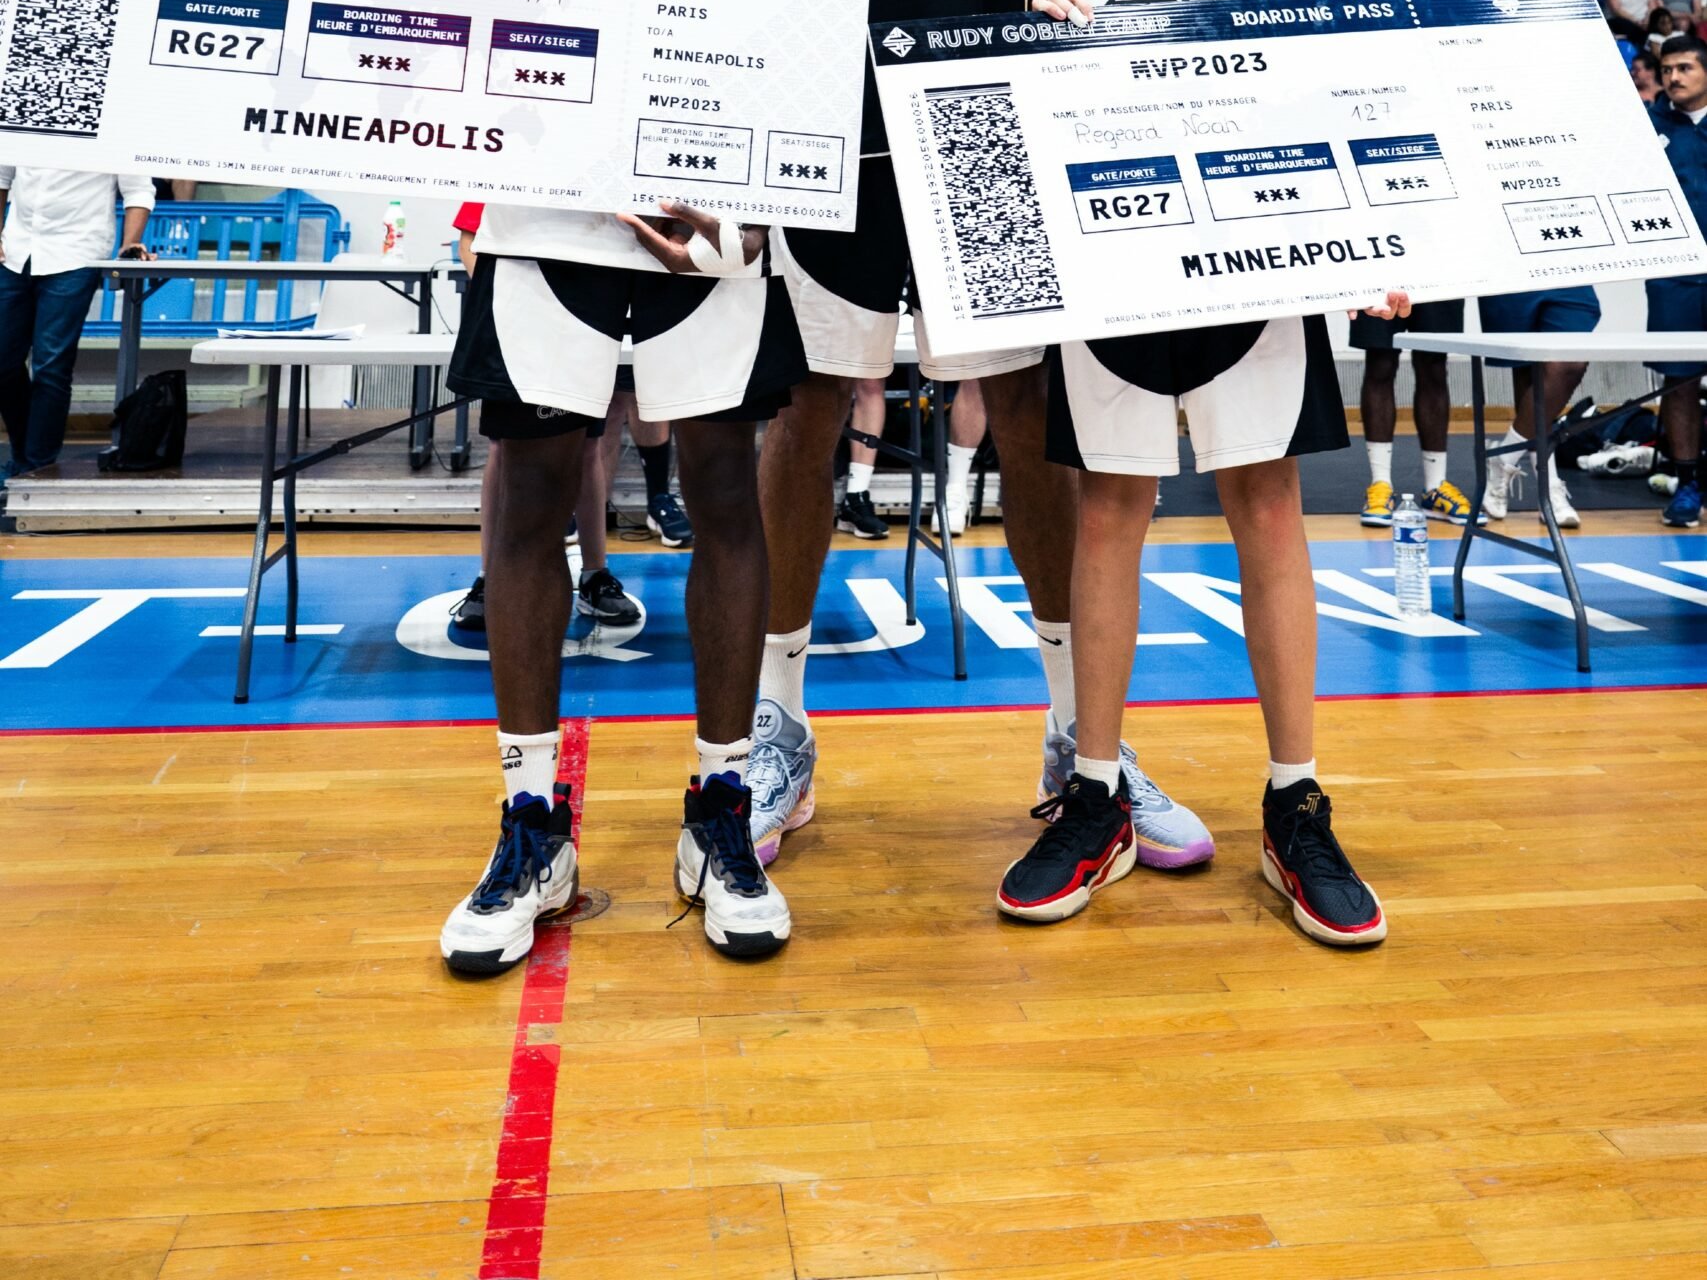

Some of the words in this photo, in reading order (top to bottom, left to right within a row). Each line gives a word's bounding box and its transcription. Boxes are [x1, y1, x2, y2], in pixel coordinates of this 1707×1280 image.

[185, 2, 260, 18] GATE/PORTE
[343, 9, 402, 24] BOARDING
[409, 15, 438, 27] TIME
[657, 4, 708, 20] PARIS
[1231, 4, 1333, 27] BOARDING
[1344, 3, 1394, 20] PASS
[316, 20, 353, 33] HEURE
[360, 23, 462, 42] D'EMBARQUEMENT
[647, 26, 674, 38] TO/A
[927, 26, 993, 50] RUDY
[168, 28, 265, 61] RG27
[509, 32, 580, 49] SEAT/SIEGE
[653, 47, 765, 70] MINNEAPOLIS
[1130, 52, 1268, 80] MVP2023
[642, 73, 710, 88] FLIGHT/VOL
[649, 94, 721, 113] MVP2023
[1053, 110, 1079, 120] NAME
[1085, 108, 1098, 117] OF
[1103, 100, 1186, 116] PASSENGER/NOM
[1190, 99, 1203, 110] DU
[1208, 96, 1257, 108] PASSAGER
[1470, 99, 1513, 113] PARIS
[244, 107, 505, 153] MINNEAPOLIS
[661, 127, 703, 139] BOARDING
[642, 135, 669, 145] HEURE
[1224, 150, 1275, 163] BOARDING
[1280, 148, 1305, 158] TIME
[1366, 144, 1425, 158] SEAT/SIEGE
[1091, 167, 1157, 182] GATE/PORTE
[1205, 165, 1238, 176] HEURE
[1244, 157, 1328, 173] D'EMBARQUEMENT
[134, 154, 182, 166] BOARDING
[187, 159, 211, 169] ENDS
[217, 160, 246, 171] 15MIN
[250, 163, 285, 174] BEFORE
[433, 178, 461, 189] FERME
[467, 181, 495, 192] 15MIN
[500, 183, 528, 194] AVANT
[532, 187, 545, 196] LE
[549, 188, 583, 199] DEPART
[1501, 176, 1561, 192] MVP2023
[1089, 192, 1172, 221] RG27
[1181, 234, 1406, 279] MINNEAPOLIS
[757, 715, 772, 727] 27
